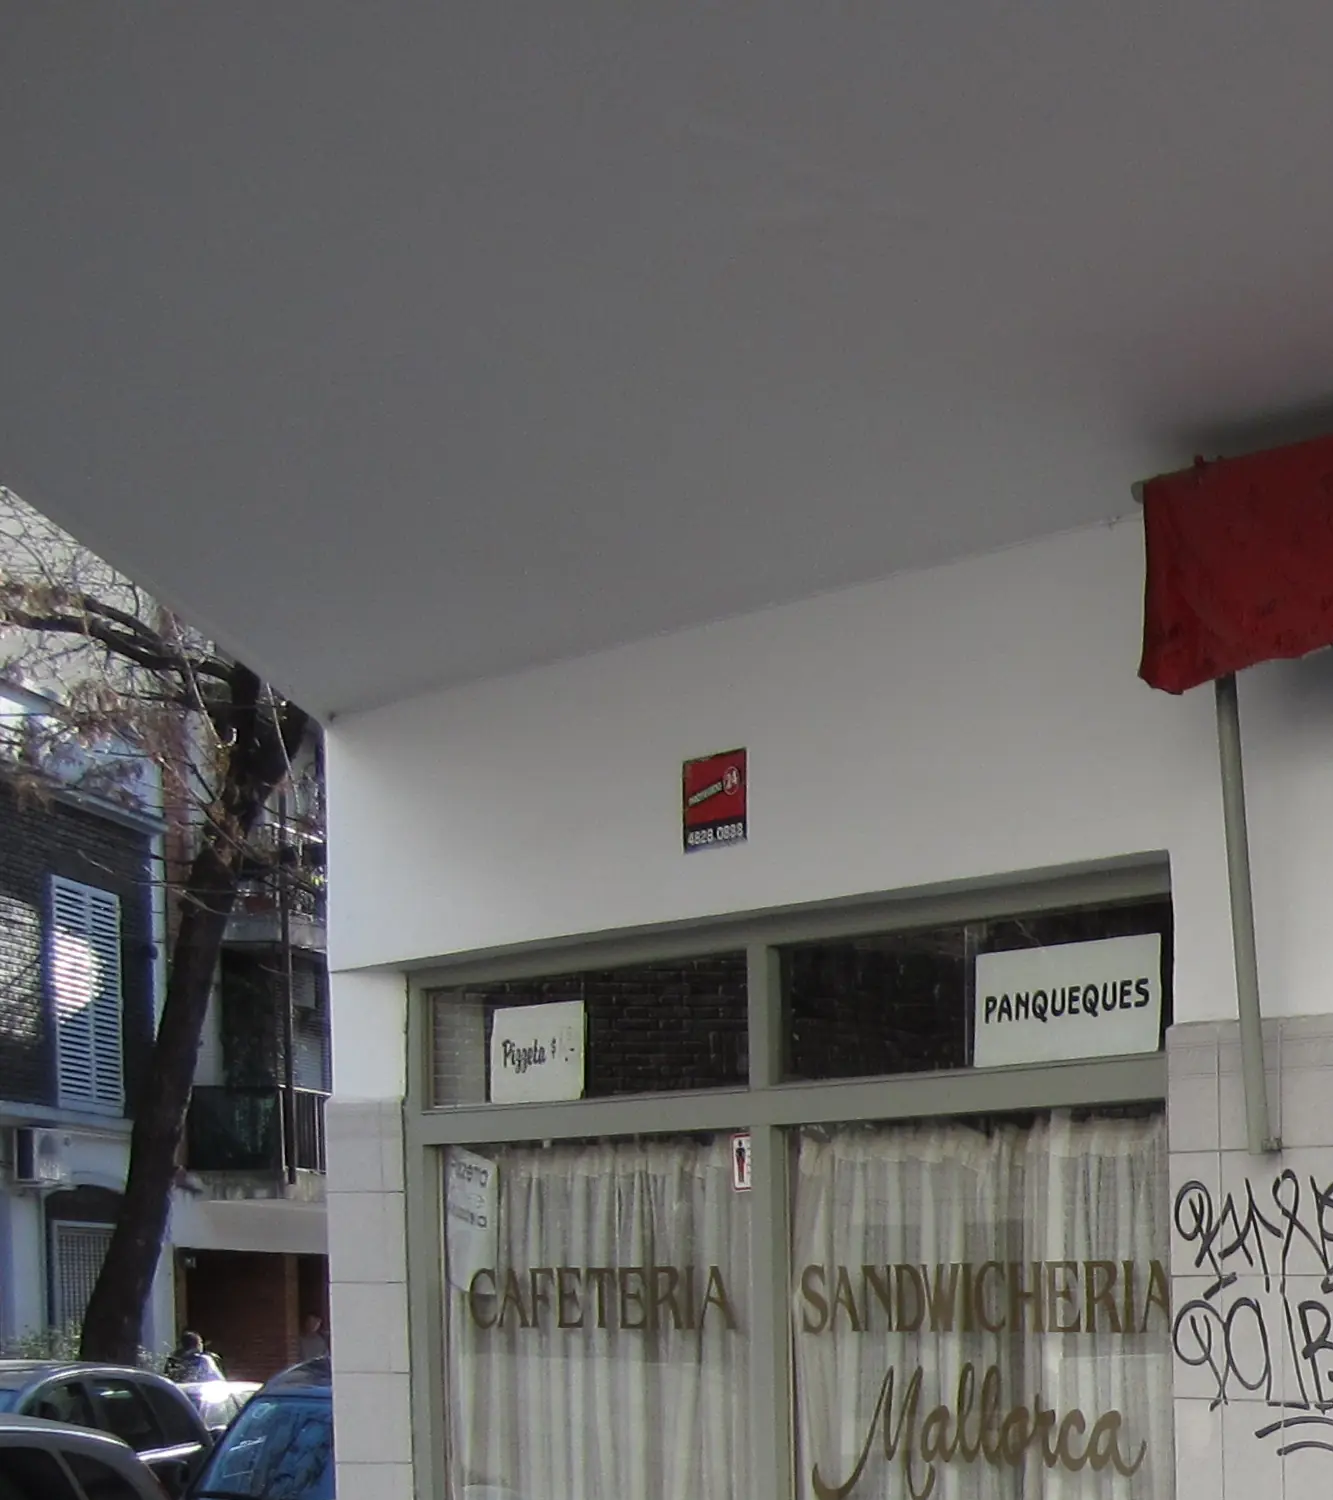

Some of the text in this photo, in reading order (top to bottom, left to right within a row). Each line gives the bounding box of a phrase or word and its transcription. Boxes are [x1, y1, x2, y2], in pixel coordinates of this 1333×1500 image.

[984, 977, 1151, 1025] PANQUEQUES
[470, 1265, 739, 1331] CAFETERIA
[800, 1259, 1171, 1335] SANDWICHERIA
